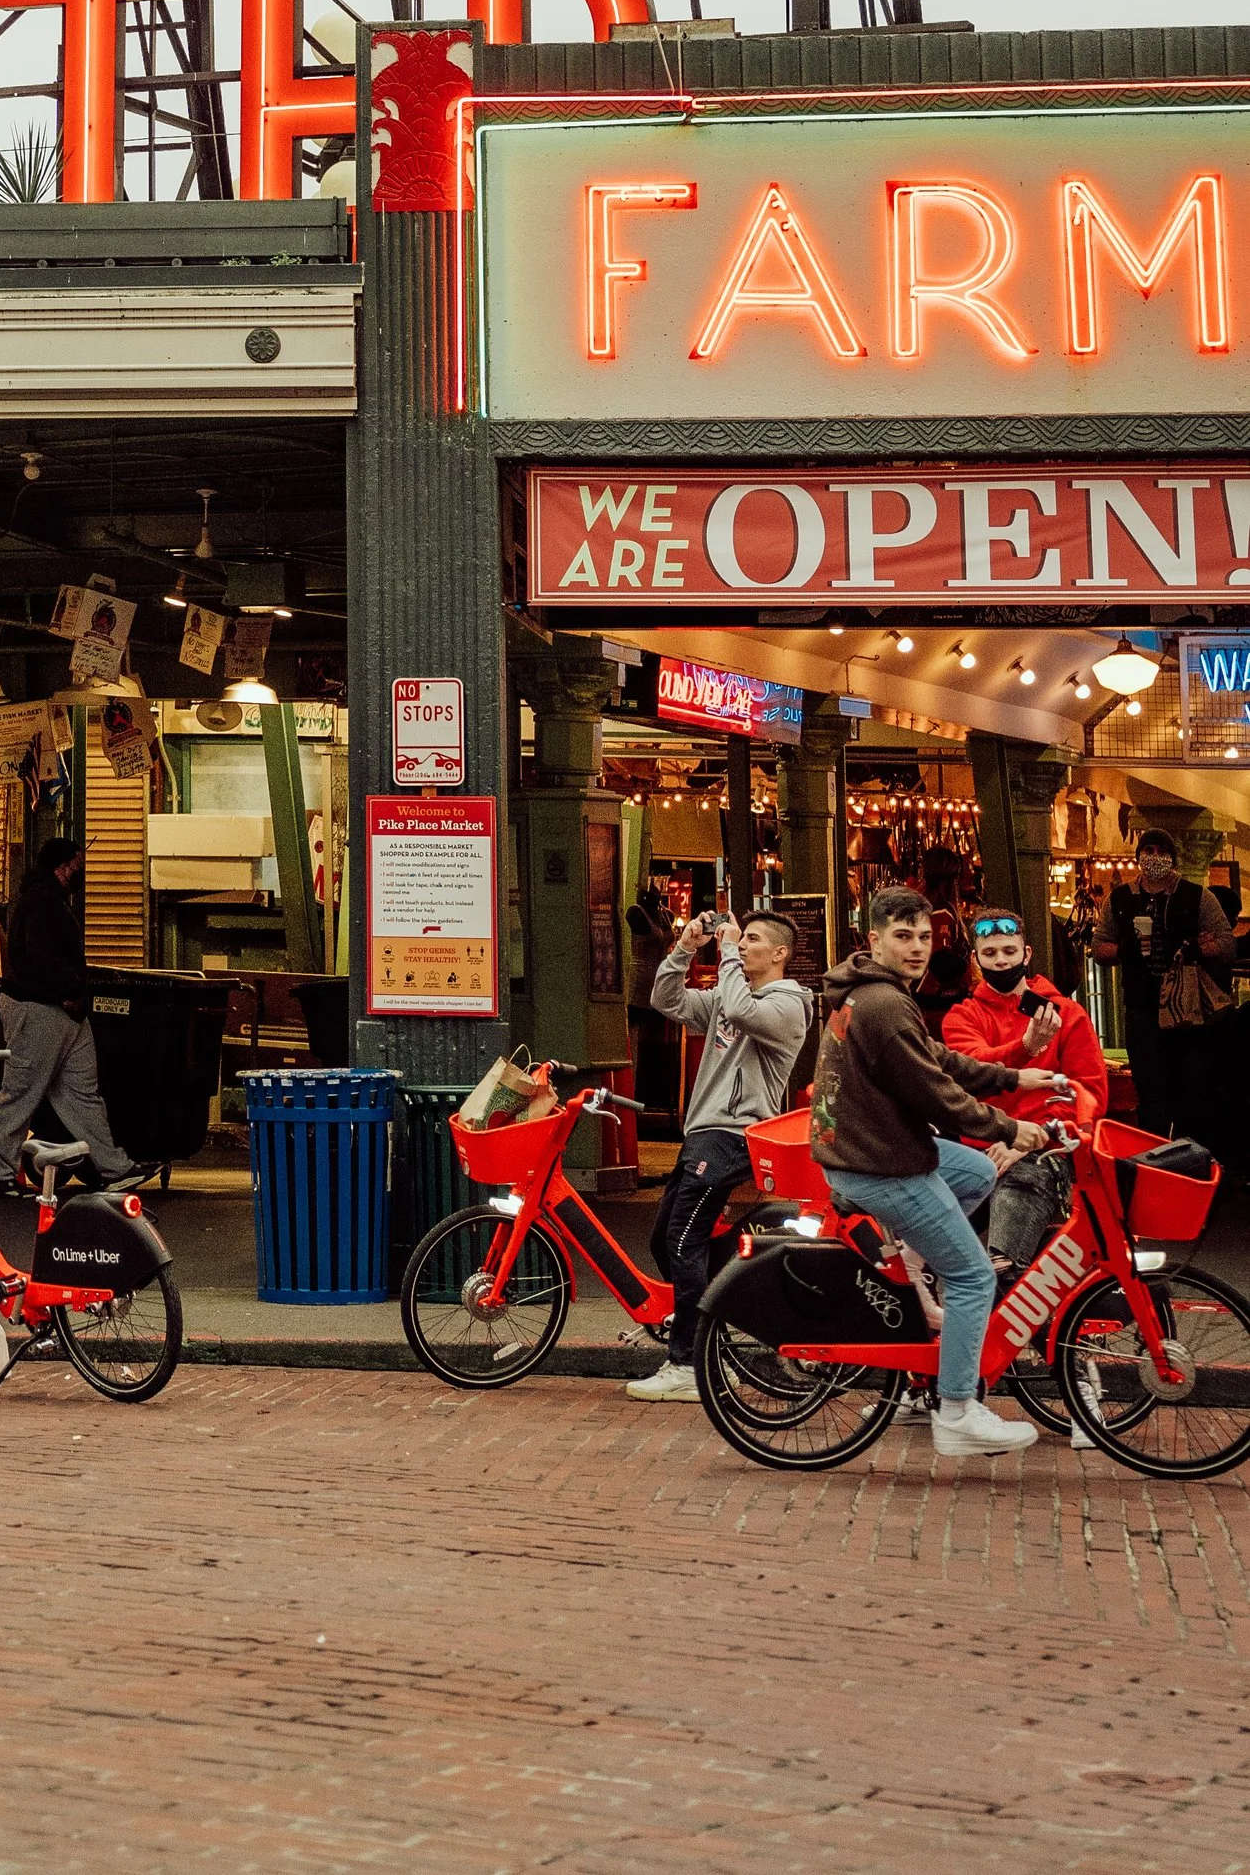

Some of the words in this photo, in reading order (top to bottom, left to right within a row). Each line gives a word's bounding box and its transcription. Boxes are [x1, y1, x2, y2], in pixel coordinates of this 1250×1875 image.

[586, 174, 1229, 361] FARM
[578, 485, 678, 532] WE
[703, 478, 1250, 589] OPEN!
[559, 539, 689, 587] ARE
[398, 684, 416, 698] NO
[403, 705, 454, 721] STOPS
[396, 805, 451, 817] Welcome
[452, 807, 466, 817] to
[378, 819, 405, 831] Pike
[406, 819, 438, 831] Place
[440, 820, 484, 831] Market
[428, 947, 456, 955] GERMS
[94, 997, 128, 1007] CARDBOARD
[53, 1247, 65, 1261] On
[65, 1247, 87, 1262] Lime
[94, 1249, 120, 1263] Uber
[998, 1233, 1087, 1347] JUMP
